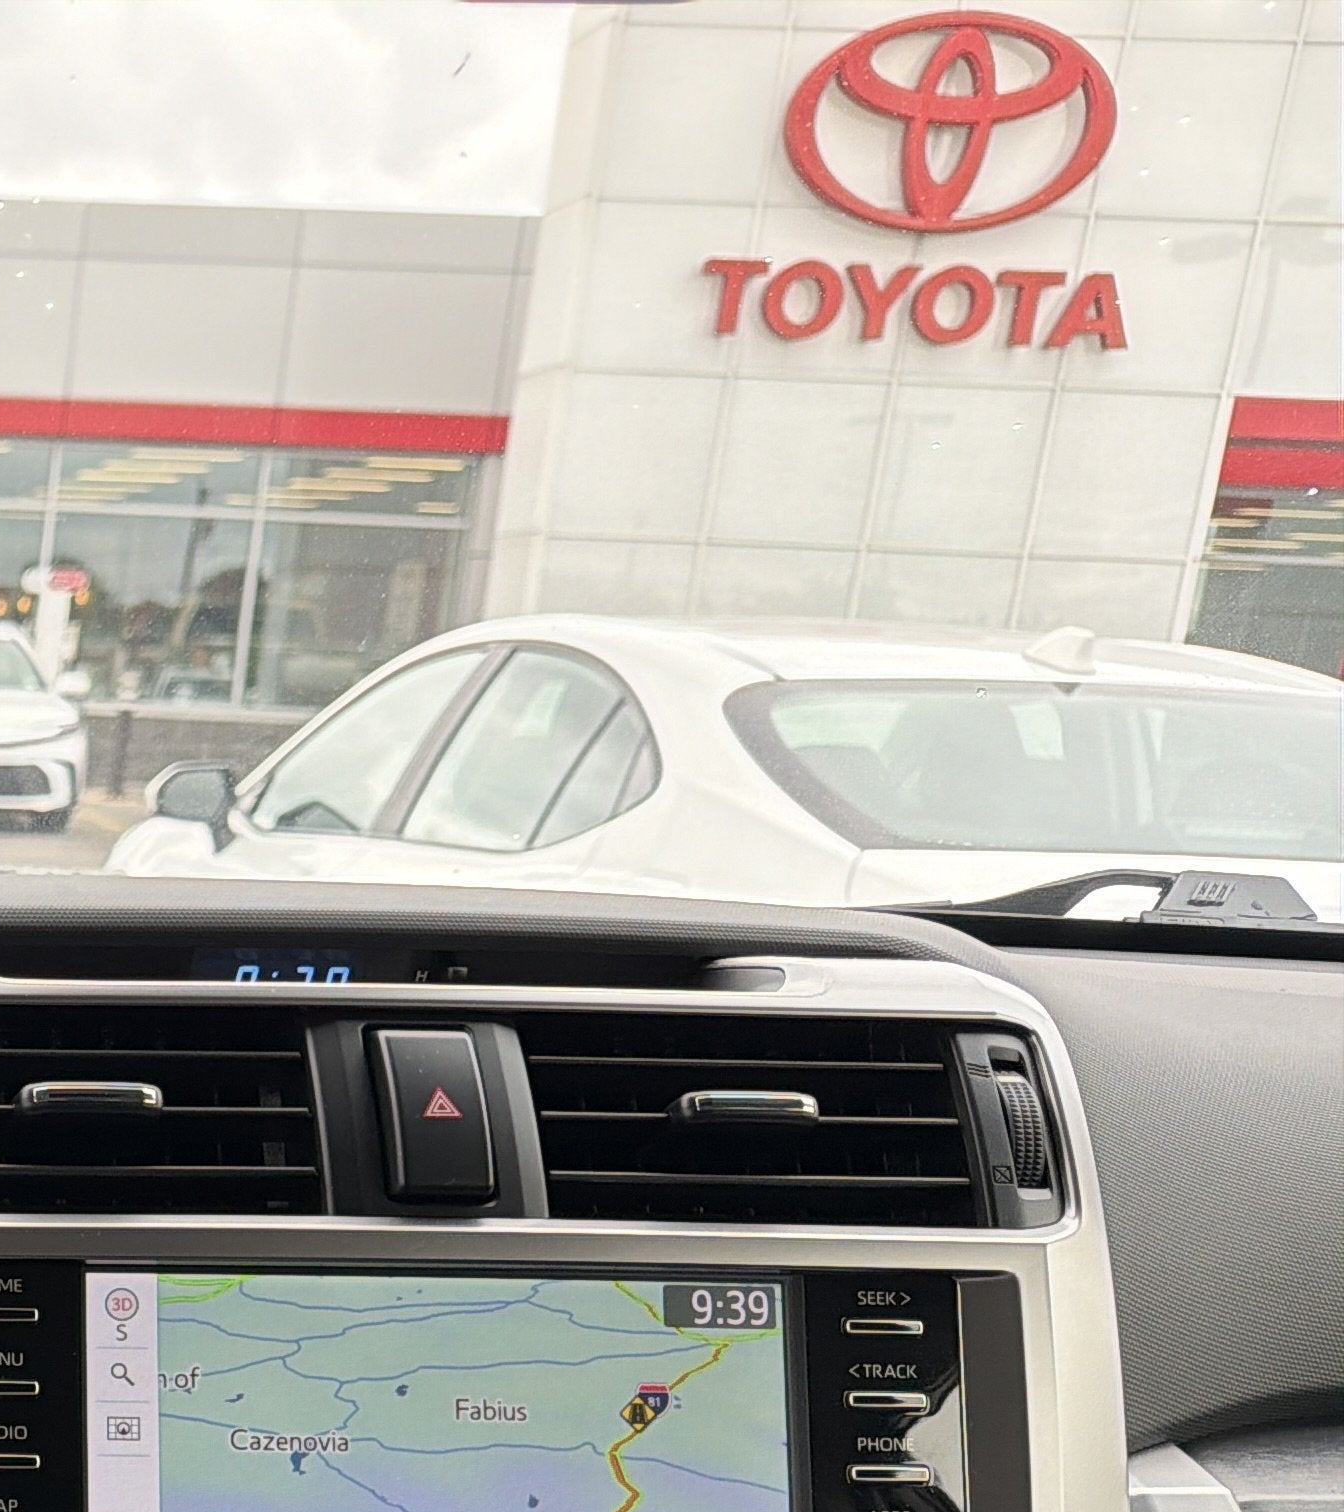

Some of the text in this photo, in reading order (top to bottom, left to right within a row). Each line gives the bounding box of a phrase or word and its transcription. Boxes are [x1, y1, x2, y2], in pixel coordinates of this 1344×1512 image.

[703, 258, 1128, 351] TOYOTA
[111, 1297, 133, 1312] 3D
[690, 1289, 770, 1327] 9:39
[115, 1323, 128, 1342] S
[454, 1398, 529, 1423] Fabius
[230, 1428, 350, 1454] Cazenovia
[857, 1437, 914, 1453] PHONE
